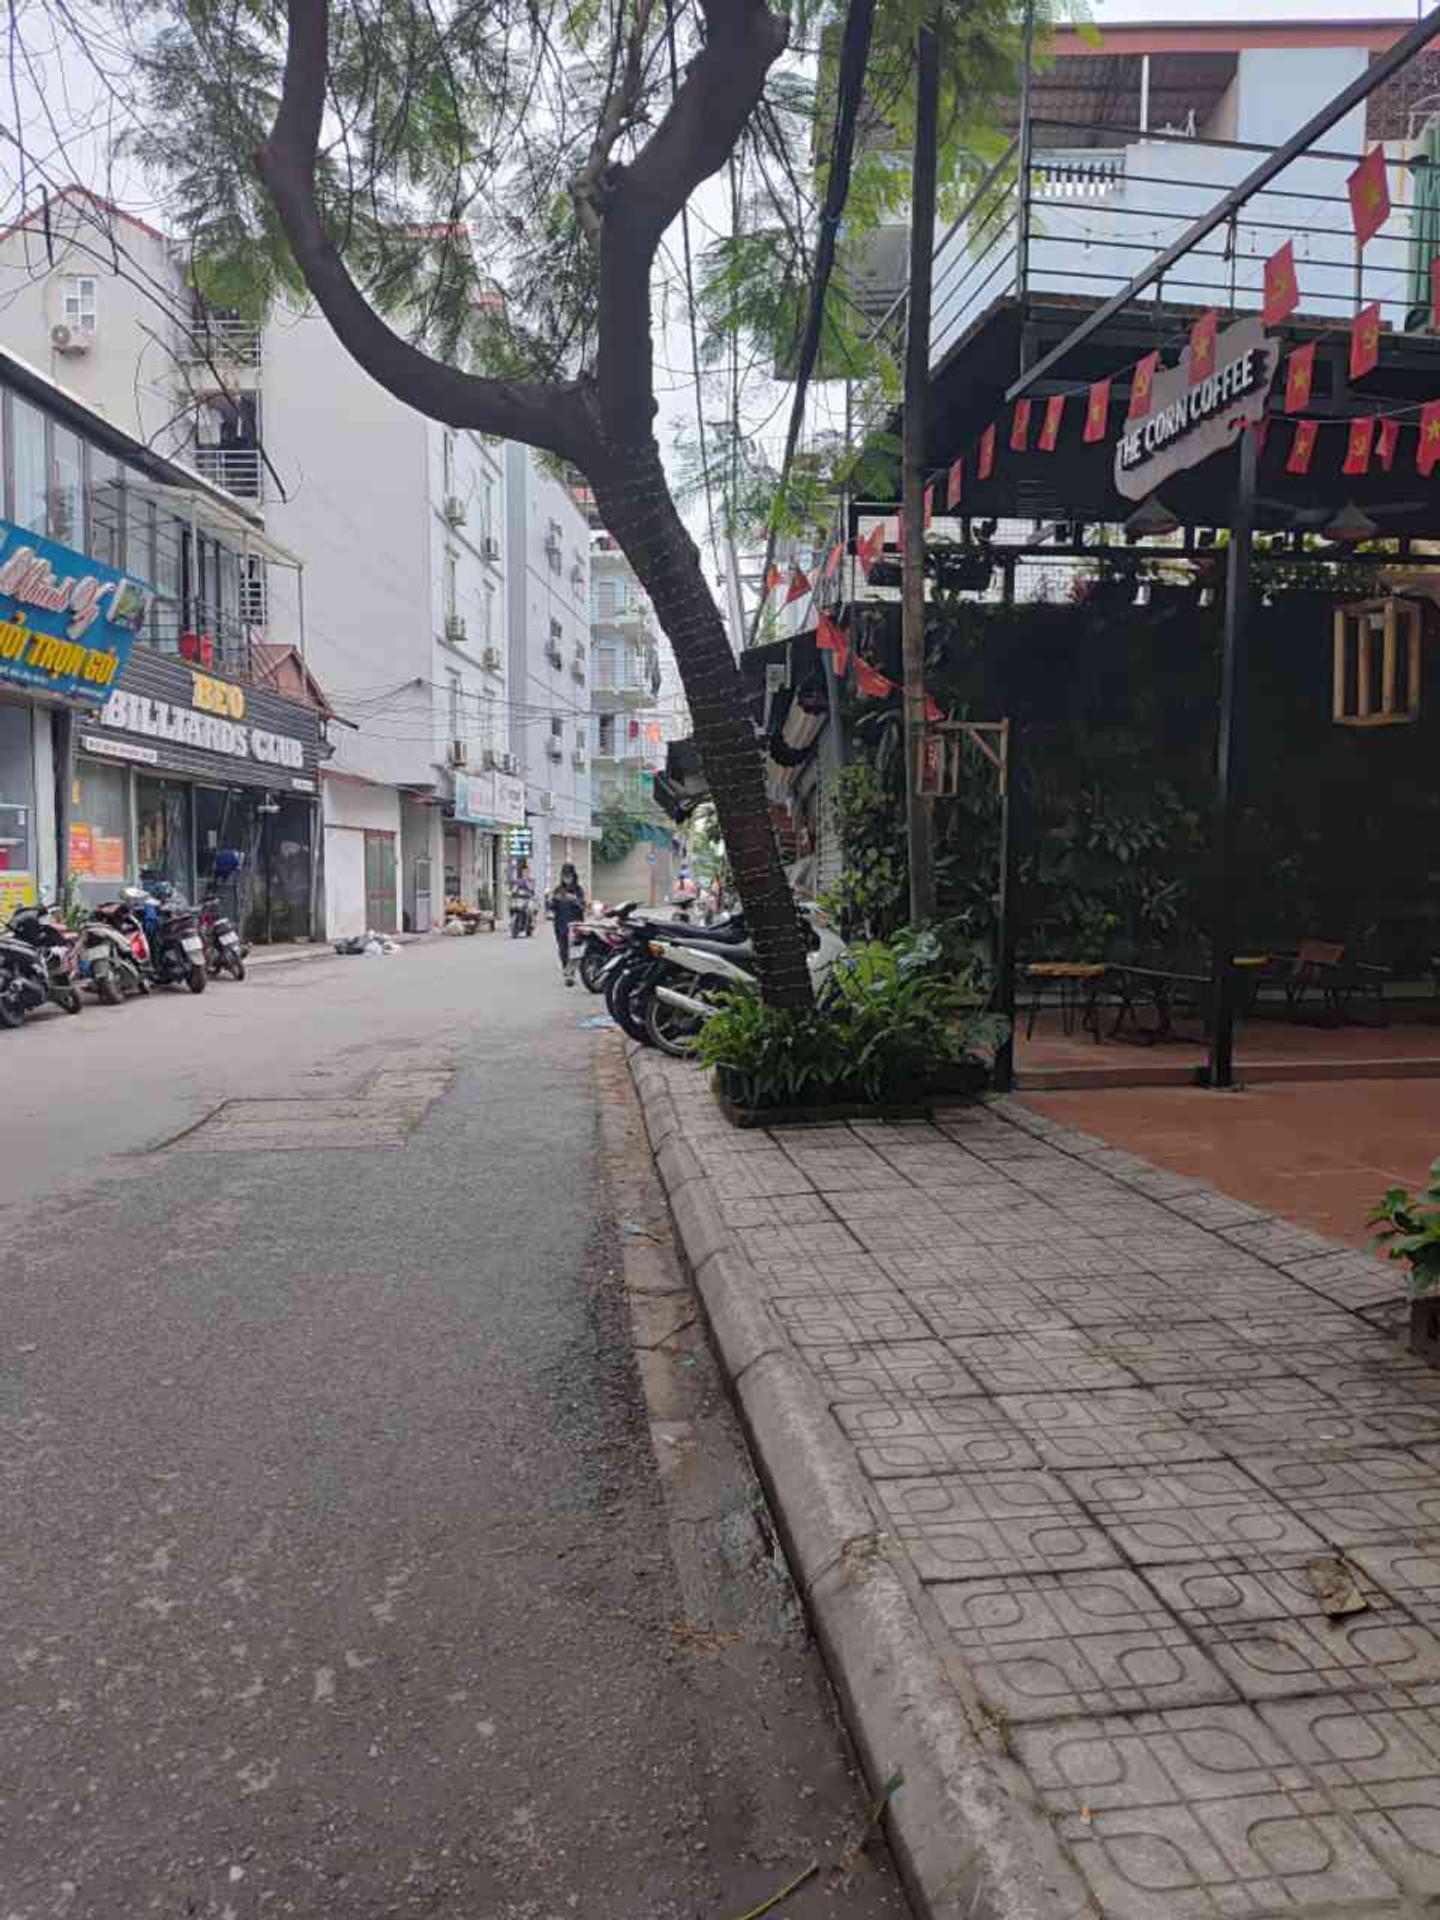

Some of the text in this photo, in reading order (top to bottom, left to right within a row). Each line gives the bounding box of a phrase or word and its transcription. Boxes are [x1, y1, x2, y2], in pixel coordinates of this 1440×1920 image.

[1116, 349, 1254, 470] THE CORN COFFEE
[250, 728, 304, 769] CLUB
